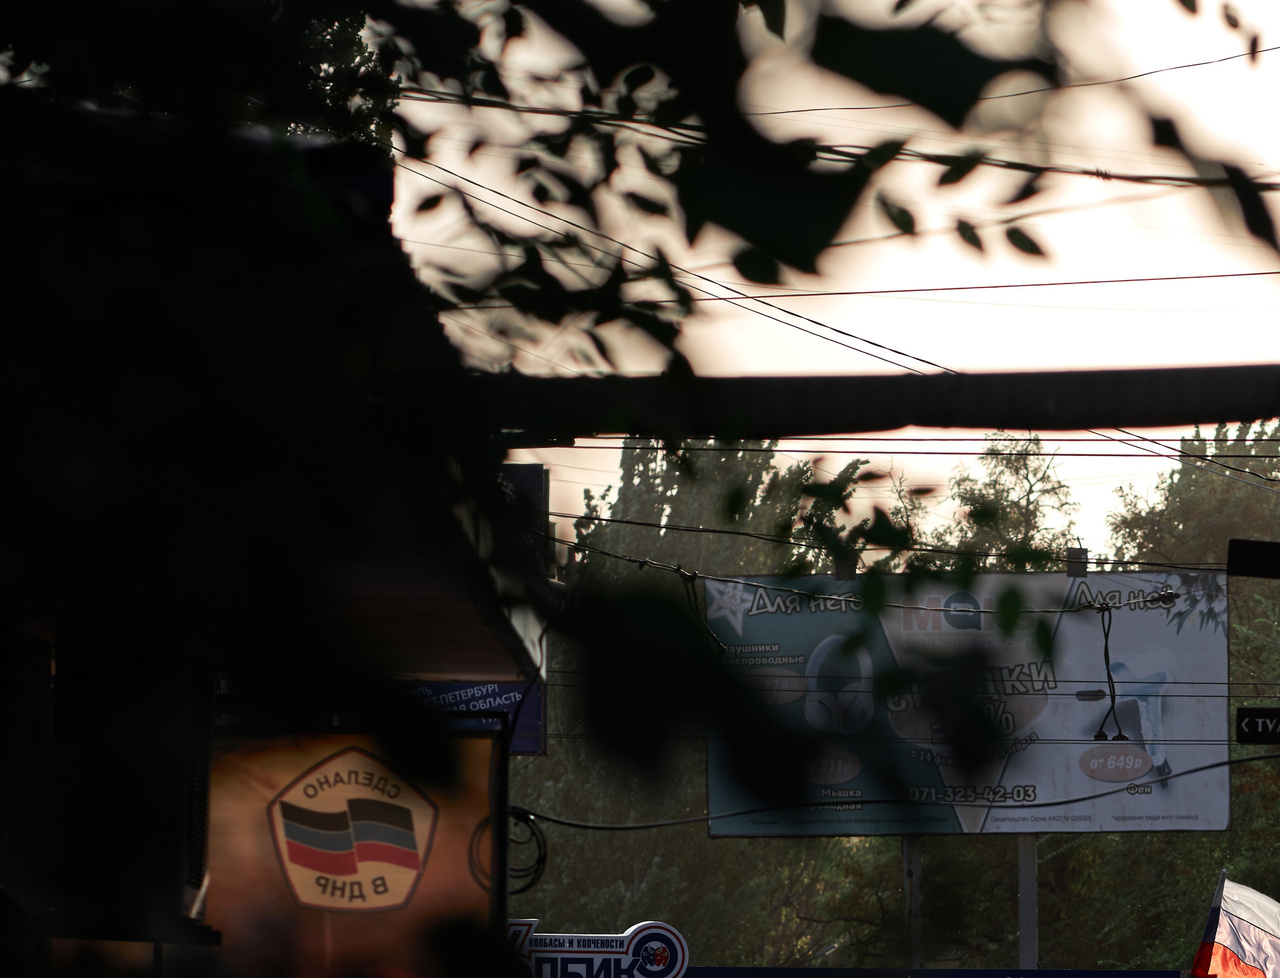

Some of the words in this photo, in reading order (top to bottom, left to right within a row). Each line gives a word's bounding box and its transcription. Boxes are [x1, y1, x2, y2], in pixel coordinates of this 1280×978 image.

[747, 587, 801, 616] Для
[469, 692, 523, 711] ОБЛАСТЬ
[920, 750, 932, 762] 14
[1090, 758, 1104, 769] от
[821, 788, 862, 798] Мышка
[908, 786, 1036, 803] 071-325-42-03
[1127, 784, 1152, 794] Фен
[529, 938, 565, 948] КОЛБАСЫ
[568, 938, 574, 948] И
[577, 938, 625, 949] КОПЧЕНОСТИ
